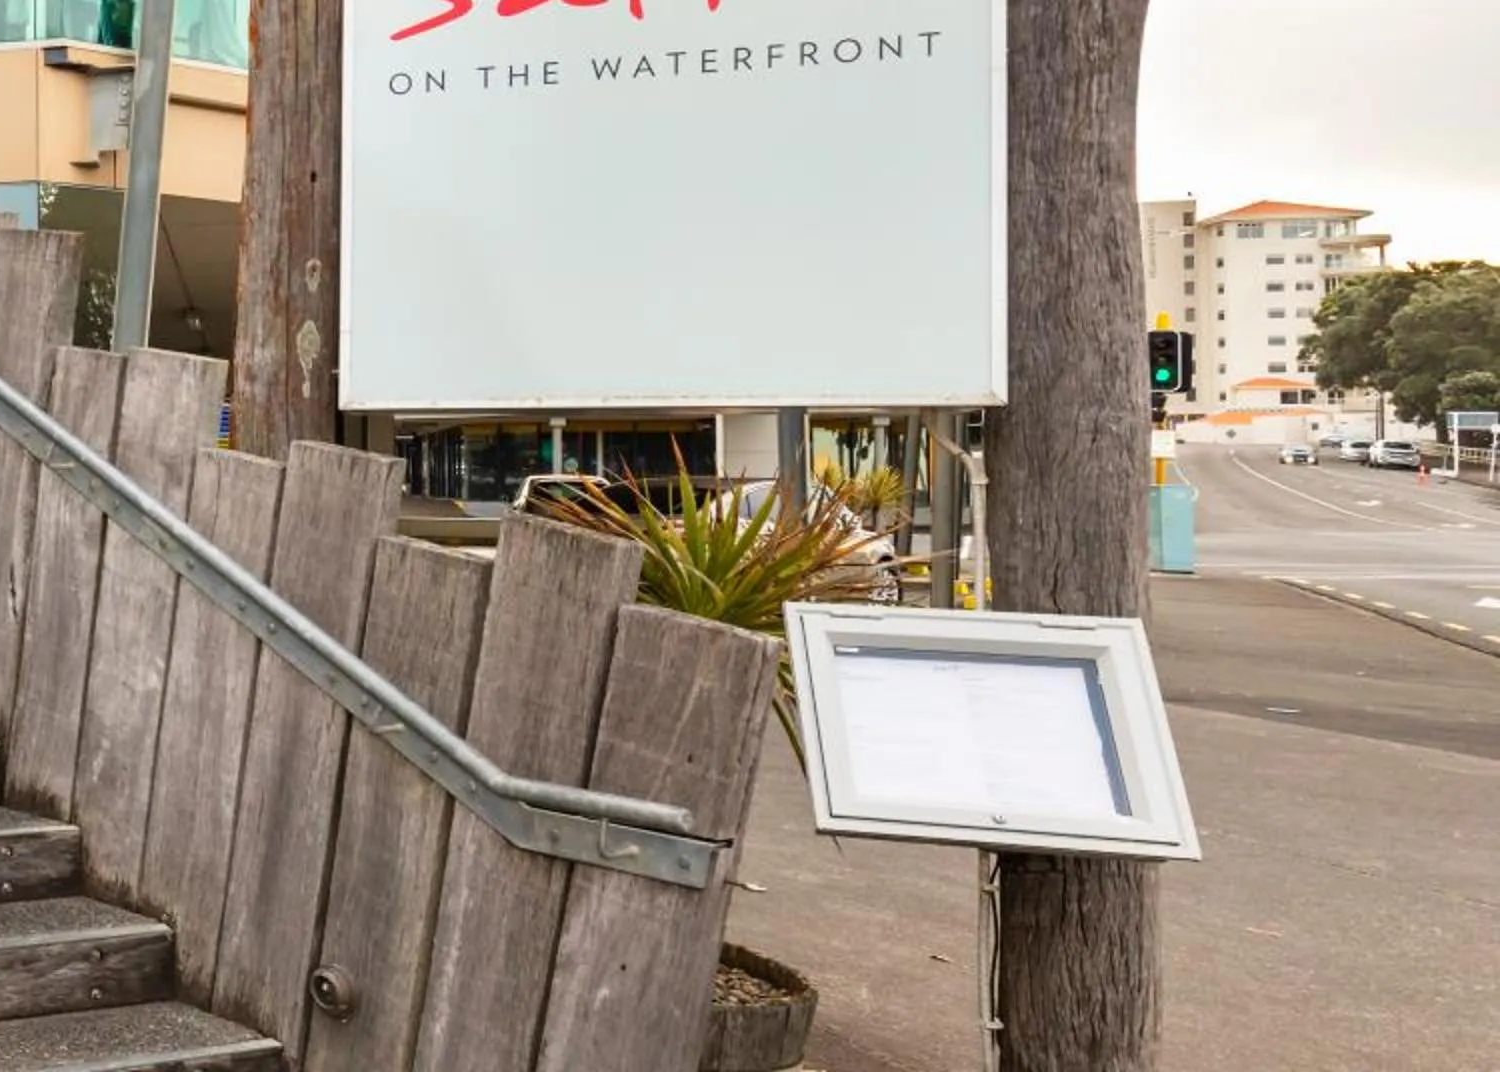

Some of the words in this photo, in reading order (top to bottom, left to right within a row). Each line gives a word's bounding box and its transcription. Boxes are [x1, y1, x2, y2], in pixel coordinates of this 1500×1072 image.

[389, 70, 446, 96] ON
[476, 61, 560, 90] THE
[591, 31, 942, 81] WATERFRONT
